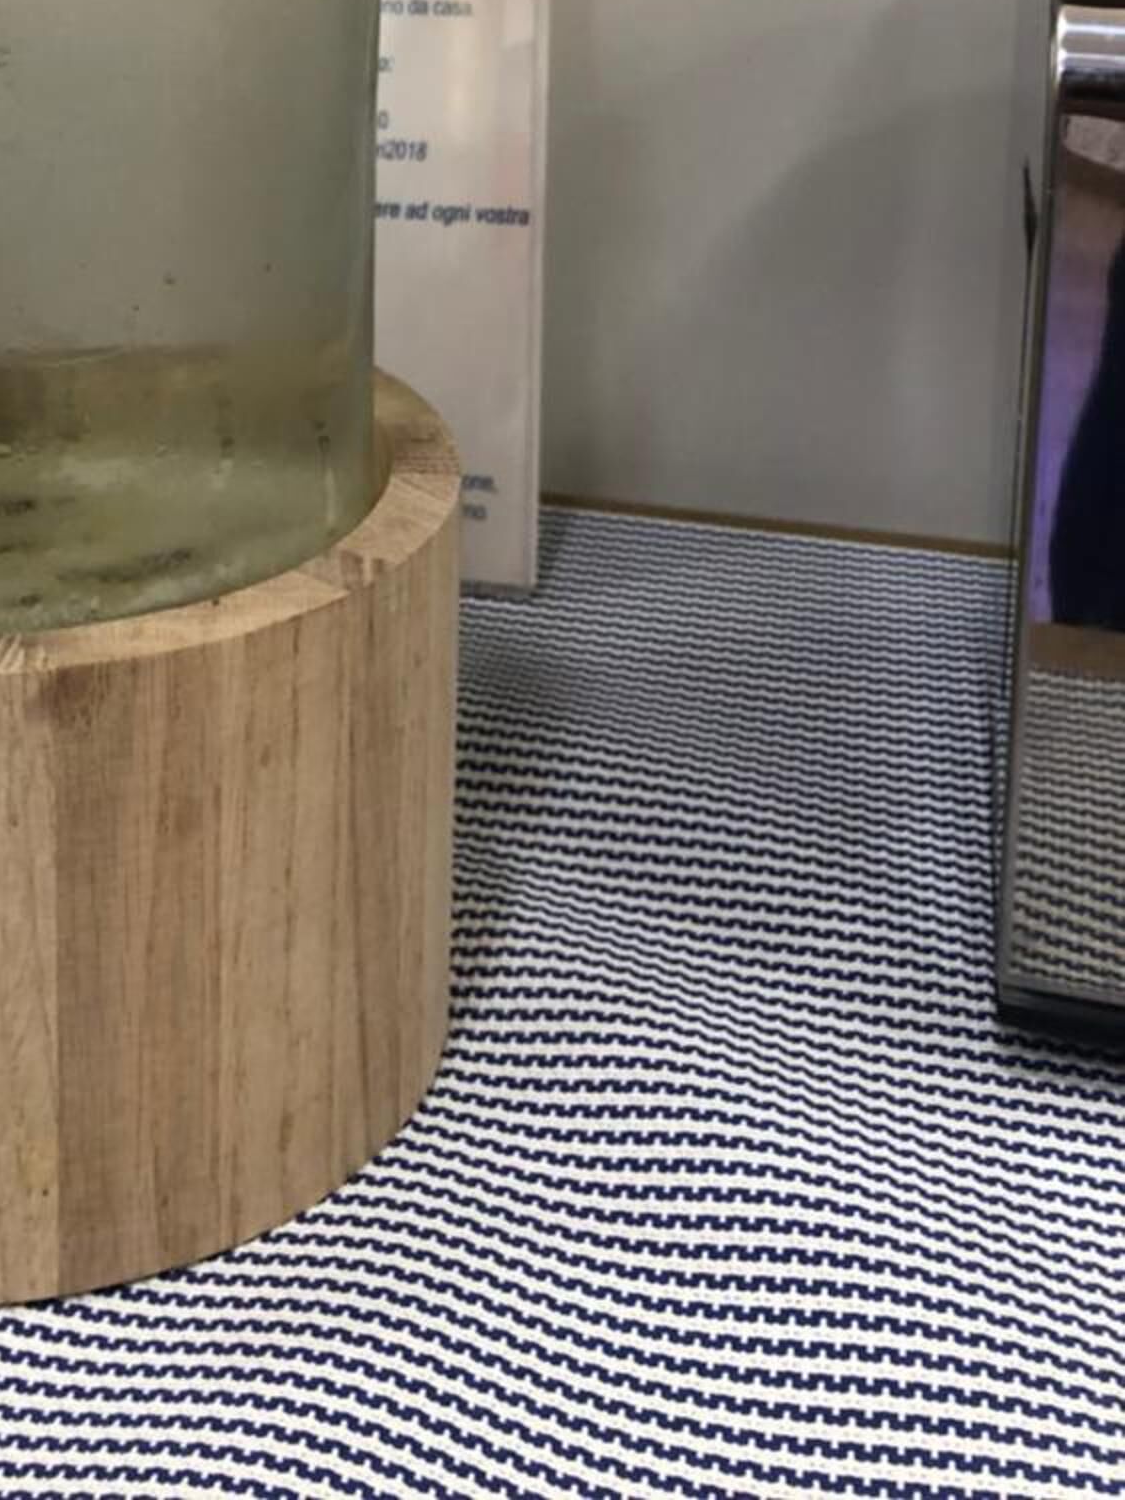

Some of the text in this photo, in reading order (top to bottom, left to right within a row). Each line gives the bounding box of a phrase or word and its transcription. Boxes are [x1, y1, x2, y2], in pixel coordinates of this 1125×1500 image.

[407, 0, 428, 15] da
[405, 203, 427, 219] ad
[431, 204, 470, 226] ogni
[475, 206, 530, 226] vostra
